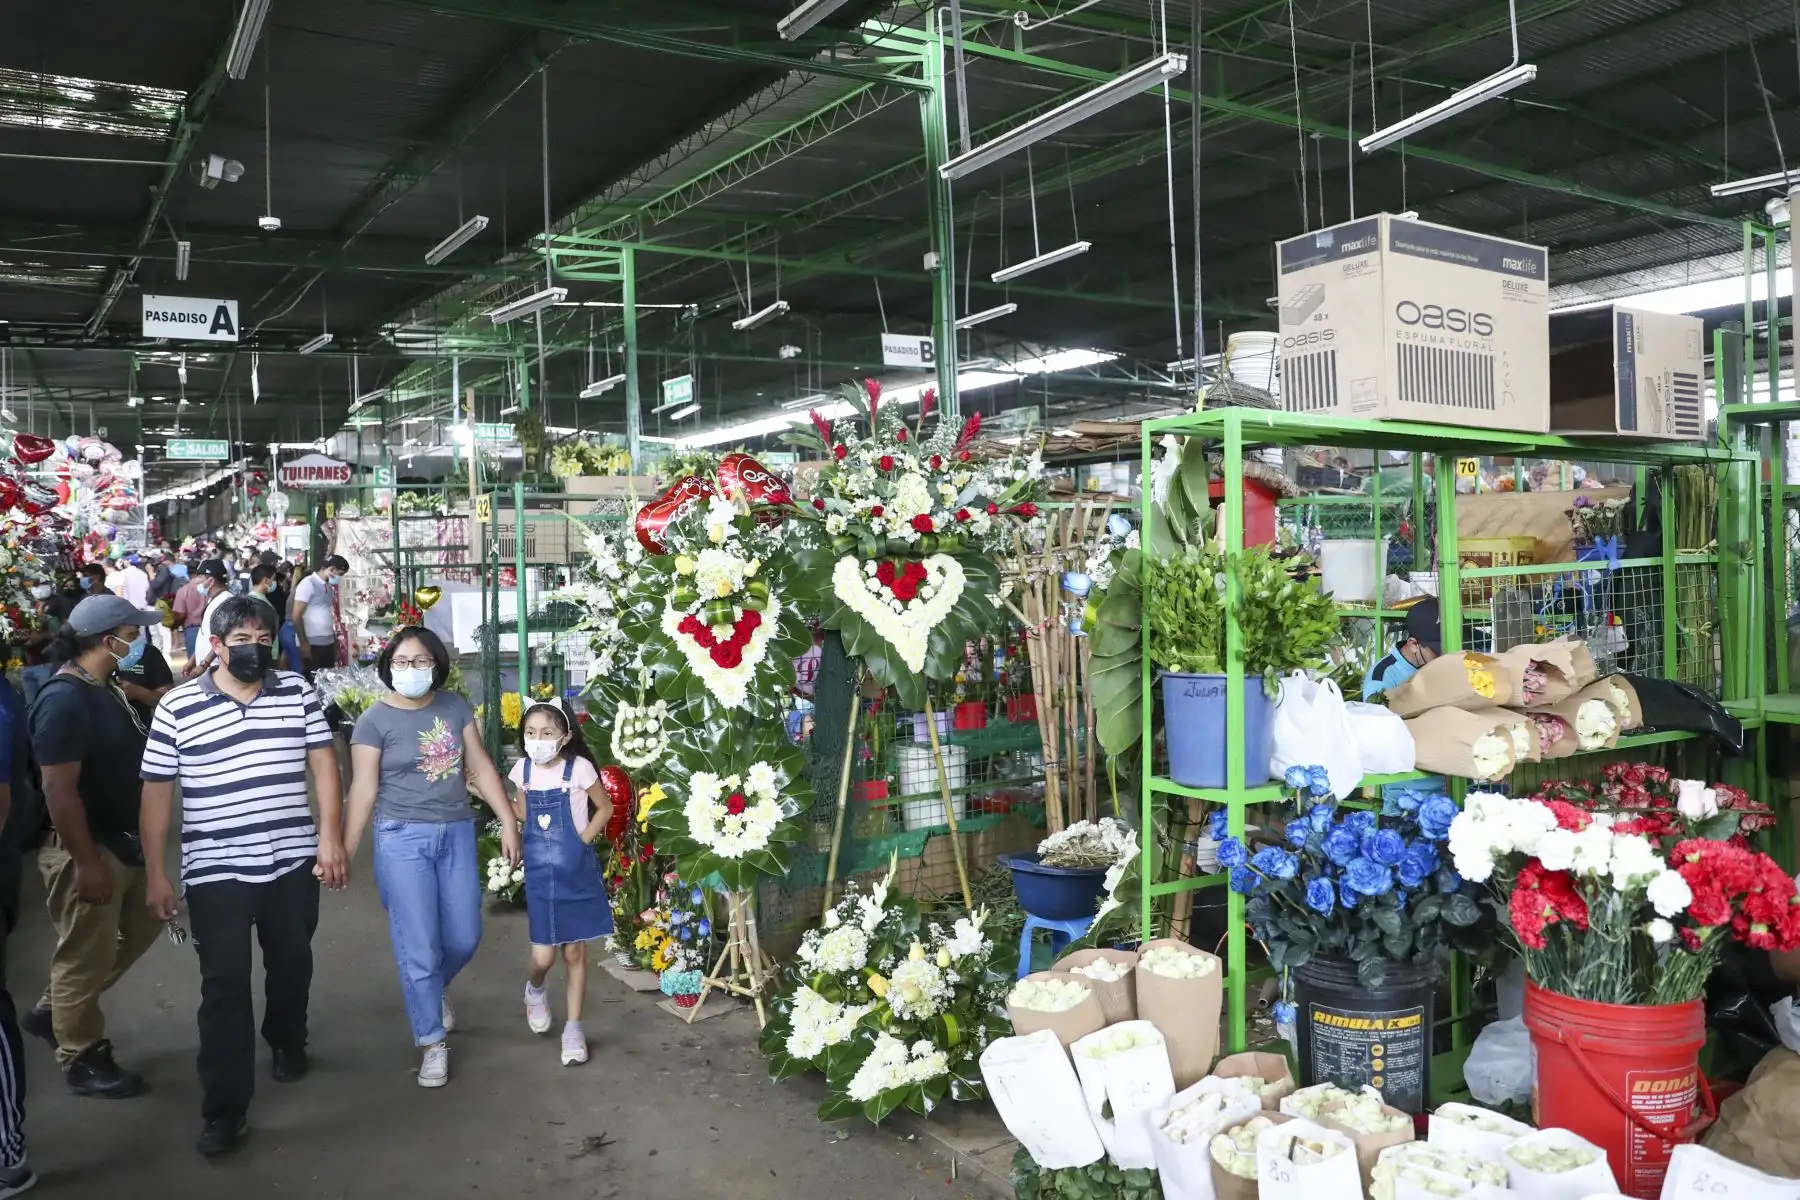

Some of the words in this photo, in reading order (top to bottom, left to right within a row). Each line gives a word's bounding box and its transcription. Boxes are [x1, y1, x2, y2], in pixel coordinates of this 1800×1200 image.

[1341, 235, 1377, 253] maxlife
[1342, 259, 1369, 273] DELUXE
[1502, 256, 1537, 274] maxlife
[1502, 279, 1529, 293] DELUXE
[145, 310, 208, 325] PASADISO
[208, 304, 236, 336] A
[1396, 329, 1446, 345] ESPUMA
[1449, 337, 1495, 352] FLORAL
[884, 344, 919, 356] PASADISO
[919, 340, 935, 363] B
[187, 443, 226, 456] SALIDA
[281, 466, 349, 481] TULIPANES
[1459, 461, 1476, 474] 70
[477, 499, 489, 518] 32
[1313, 1010, 1385, 1030] RIMULA
